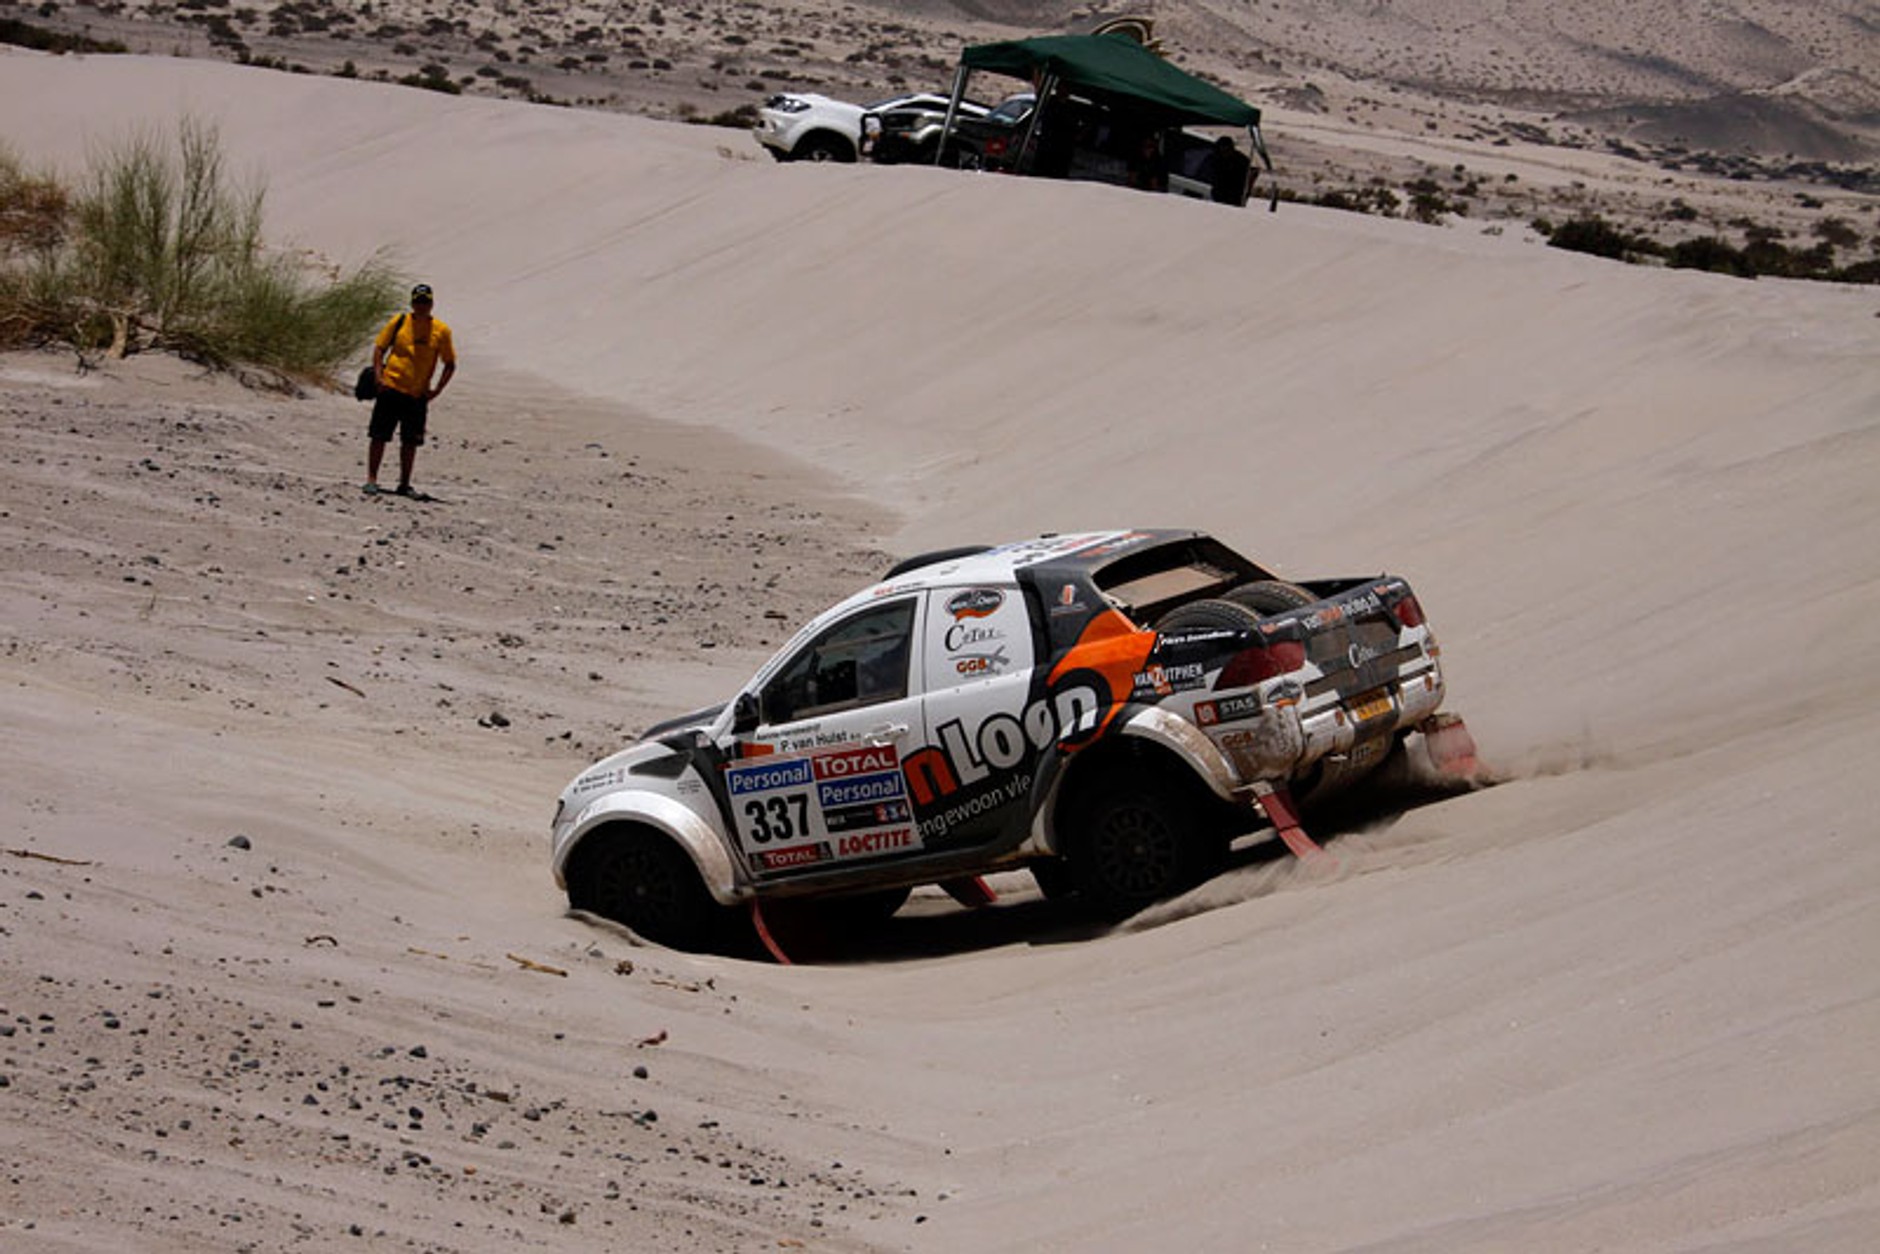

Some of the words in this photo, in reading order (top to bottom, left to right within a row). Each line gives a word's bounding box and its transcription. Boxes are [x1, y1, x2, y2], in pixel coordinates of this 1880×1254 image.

[732, 766, 808, 792] Personal
[822, 777, 899, 803] Personal
[745, 793, 810, 844] 337
[838, 829, 912, 856] LOCTITE
